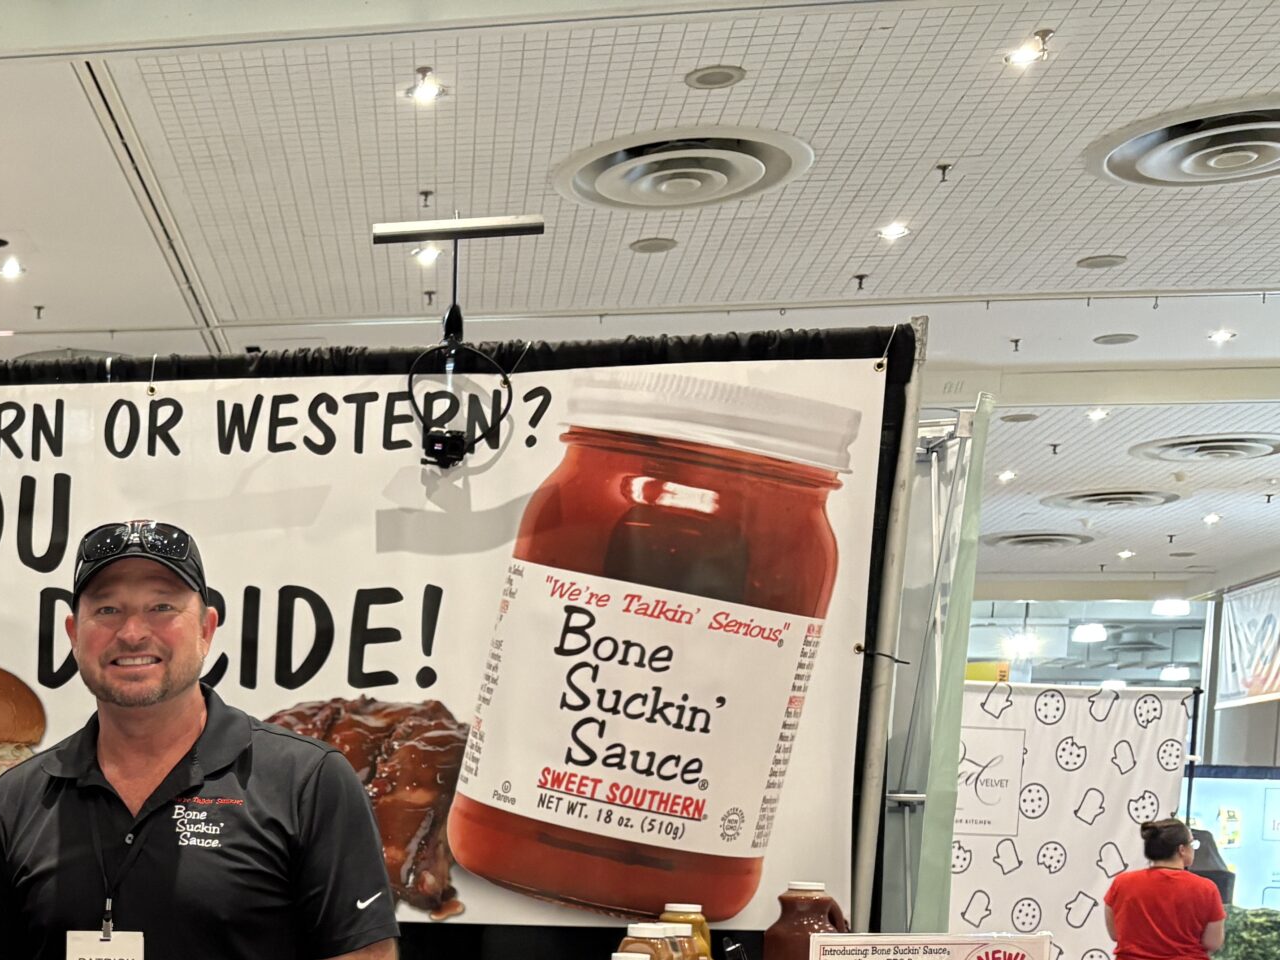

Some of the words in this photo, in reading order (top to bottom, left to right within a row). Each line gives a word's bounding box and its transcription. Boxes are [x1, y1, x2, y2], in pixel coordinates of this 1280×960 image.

[104, 398, 184, 459] OR
[546, 576, 611, 607] "We're
[622, 594, 700, 625] Talkin'
[38, 585, 444, 691] DIDE!
[554, 605, 674, 672] Bone
[560, 661, 726, 733] Suckin'
[537, 767, 603, 800] SWEET
[980, 779, 1009, 788] VELVET
[172, 805, 207, 819] Bone
[176, 818, 224, 834] Suckin'
[537, 793, 561, 812] NET
[567, 801, 588, 820] WT.
[596, 808, 613, 825] 18
[618, 815, 634, 830] oz.
[640, 816, 685, 840] (510g)
[871, 946, 891, 956] Bone
[893, 946, 921, 955] Suckin'
